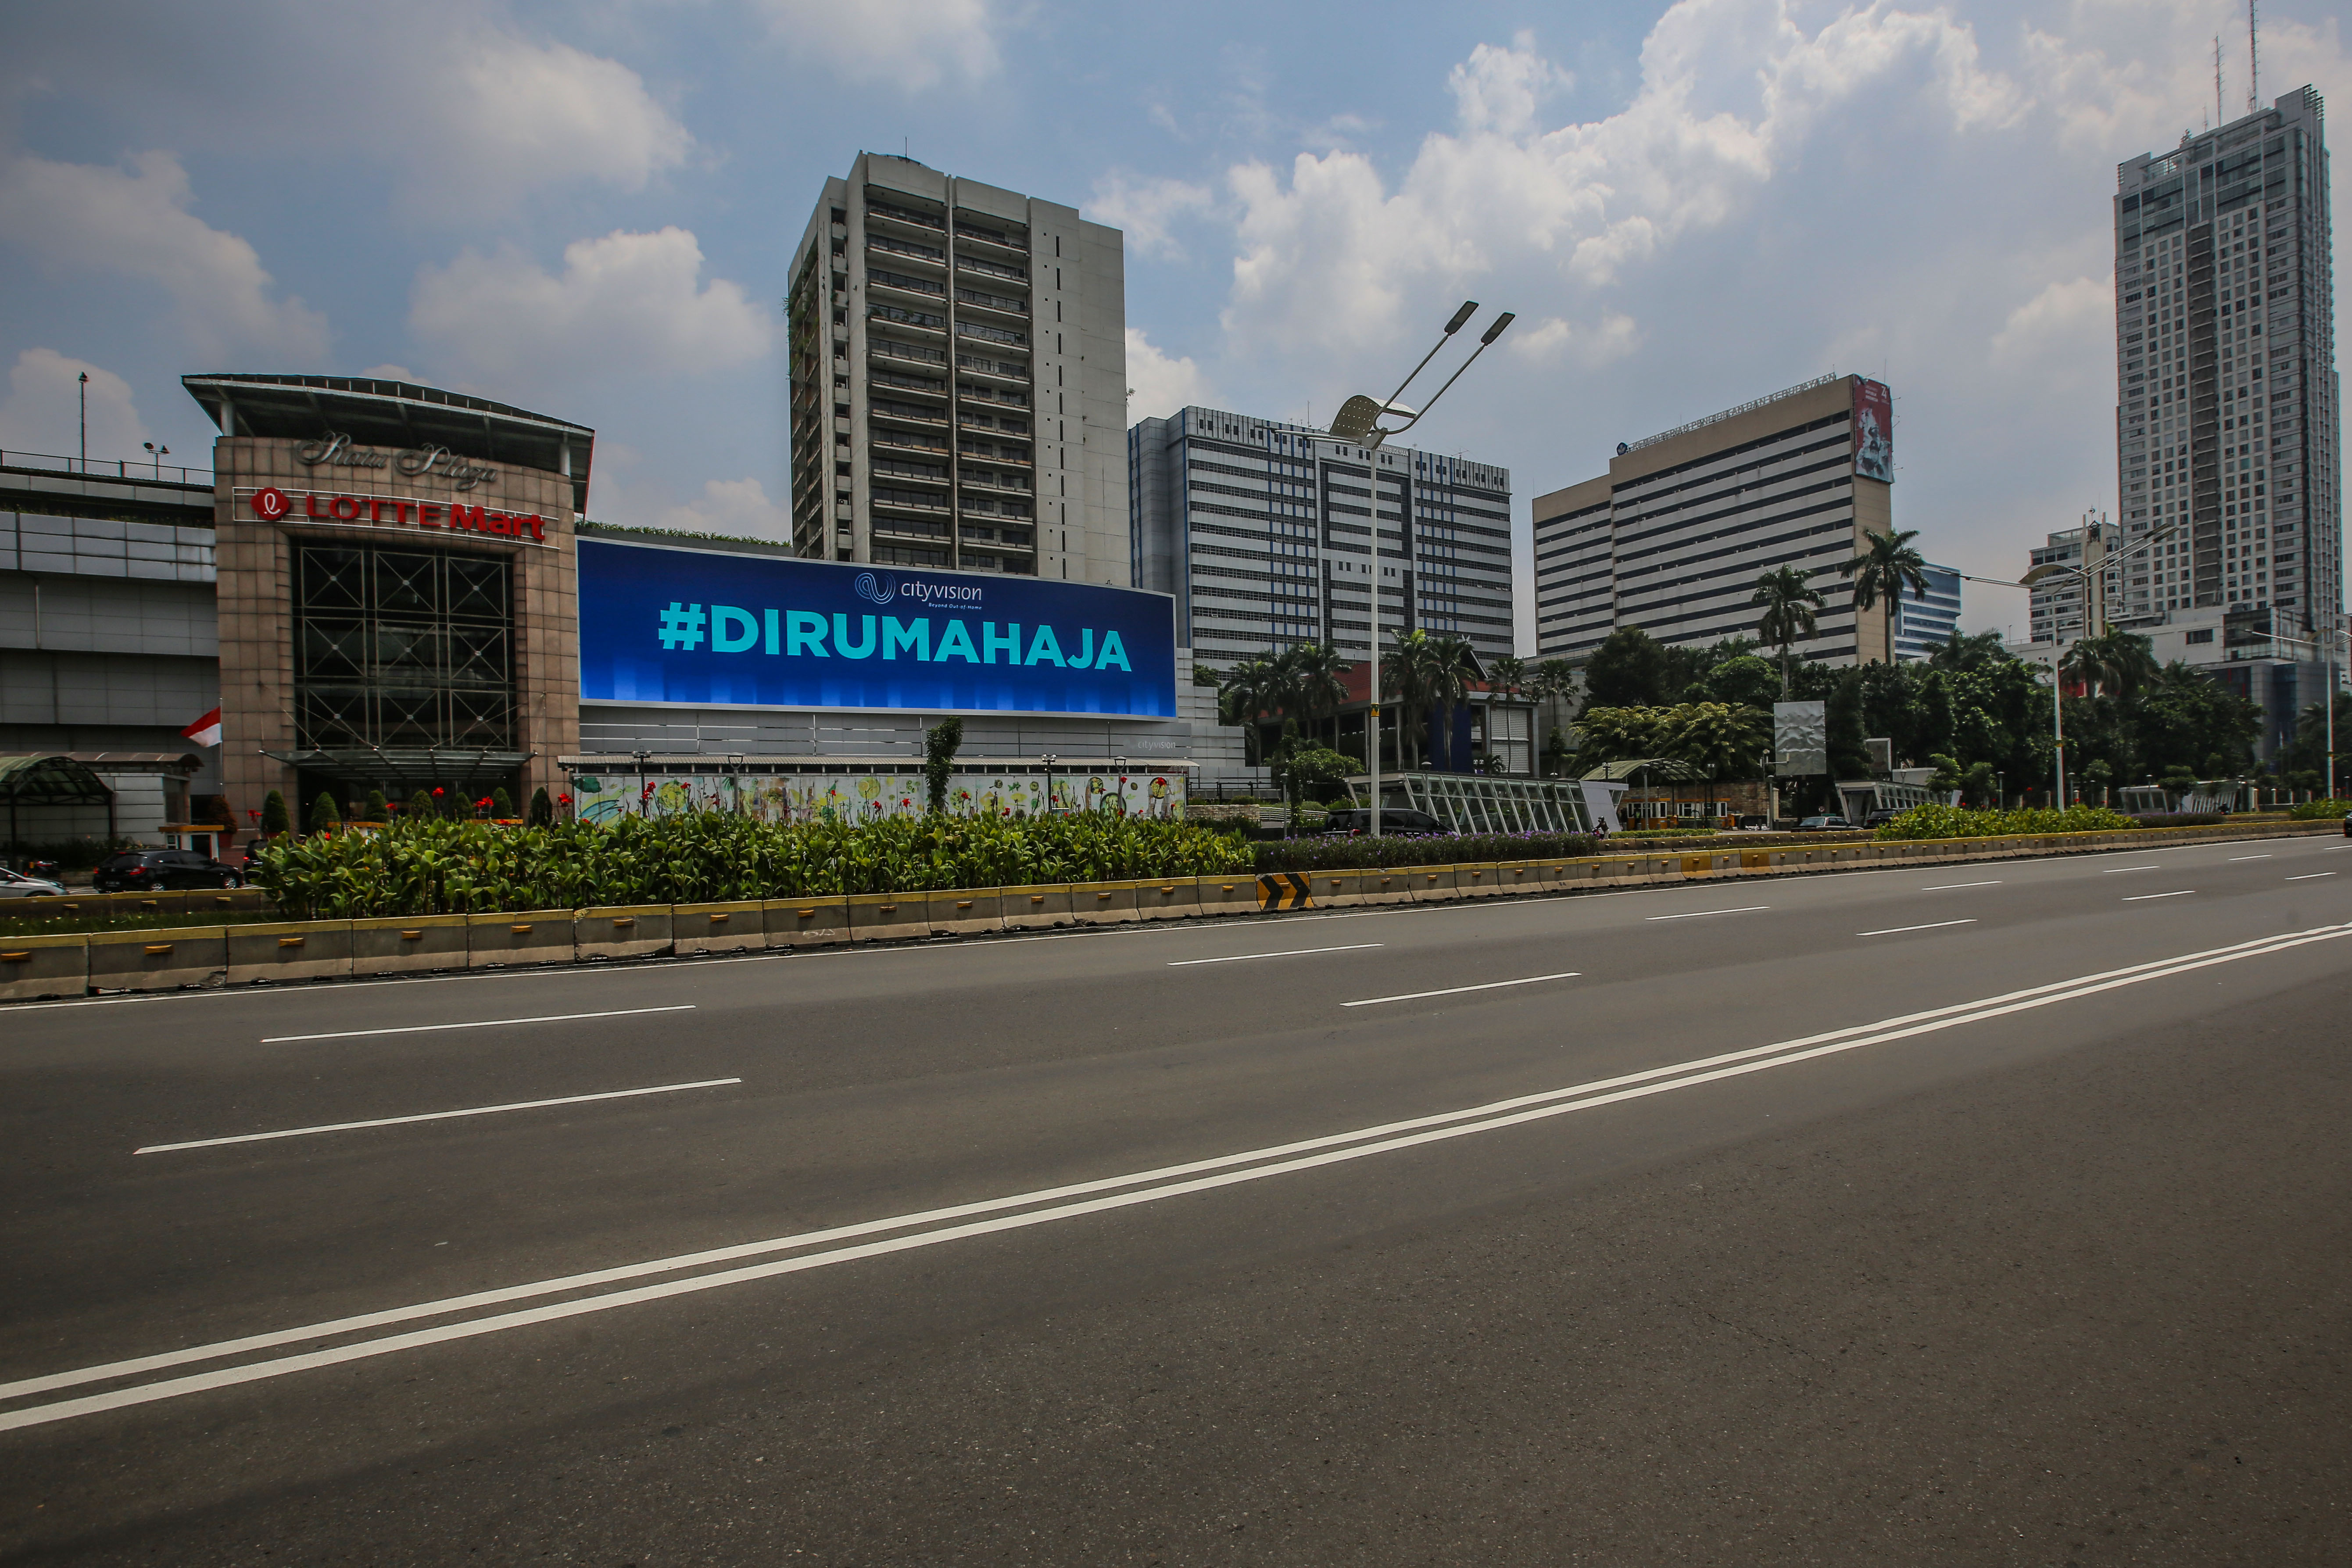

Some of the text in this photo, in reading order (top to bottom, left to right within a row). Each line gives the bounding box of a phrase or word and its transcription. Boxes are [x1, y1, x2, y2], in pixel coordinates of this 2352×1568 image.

[1747, 396, 1765, 410] DAN
[1771, 372, 1835, 403] KEBUDAYAAN
[296, 431, 498, 490] Ratu Plaza
[1384, 446, 1409, 457] KEBUDAYAAN
[306, 495, 441, 527] LOTTE
[449, 503, 545, 541] Mart
[901, 581, 982, 602] cityvision
[658, 601, 1132, 672] #DIRUMAHAJA
[1138, 740, 1176, 751] cityvision
